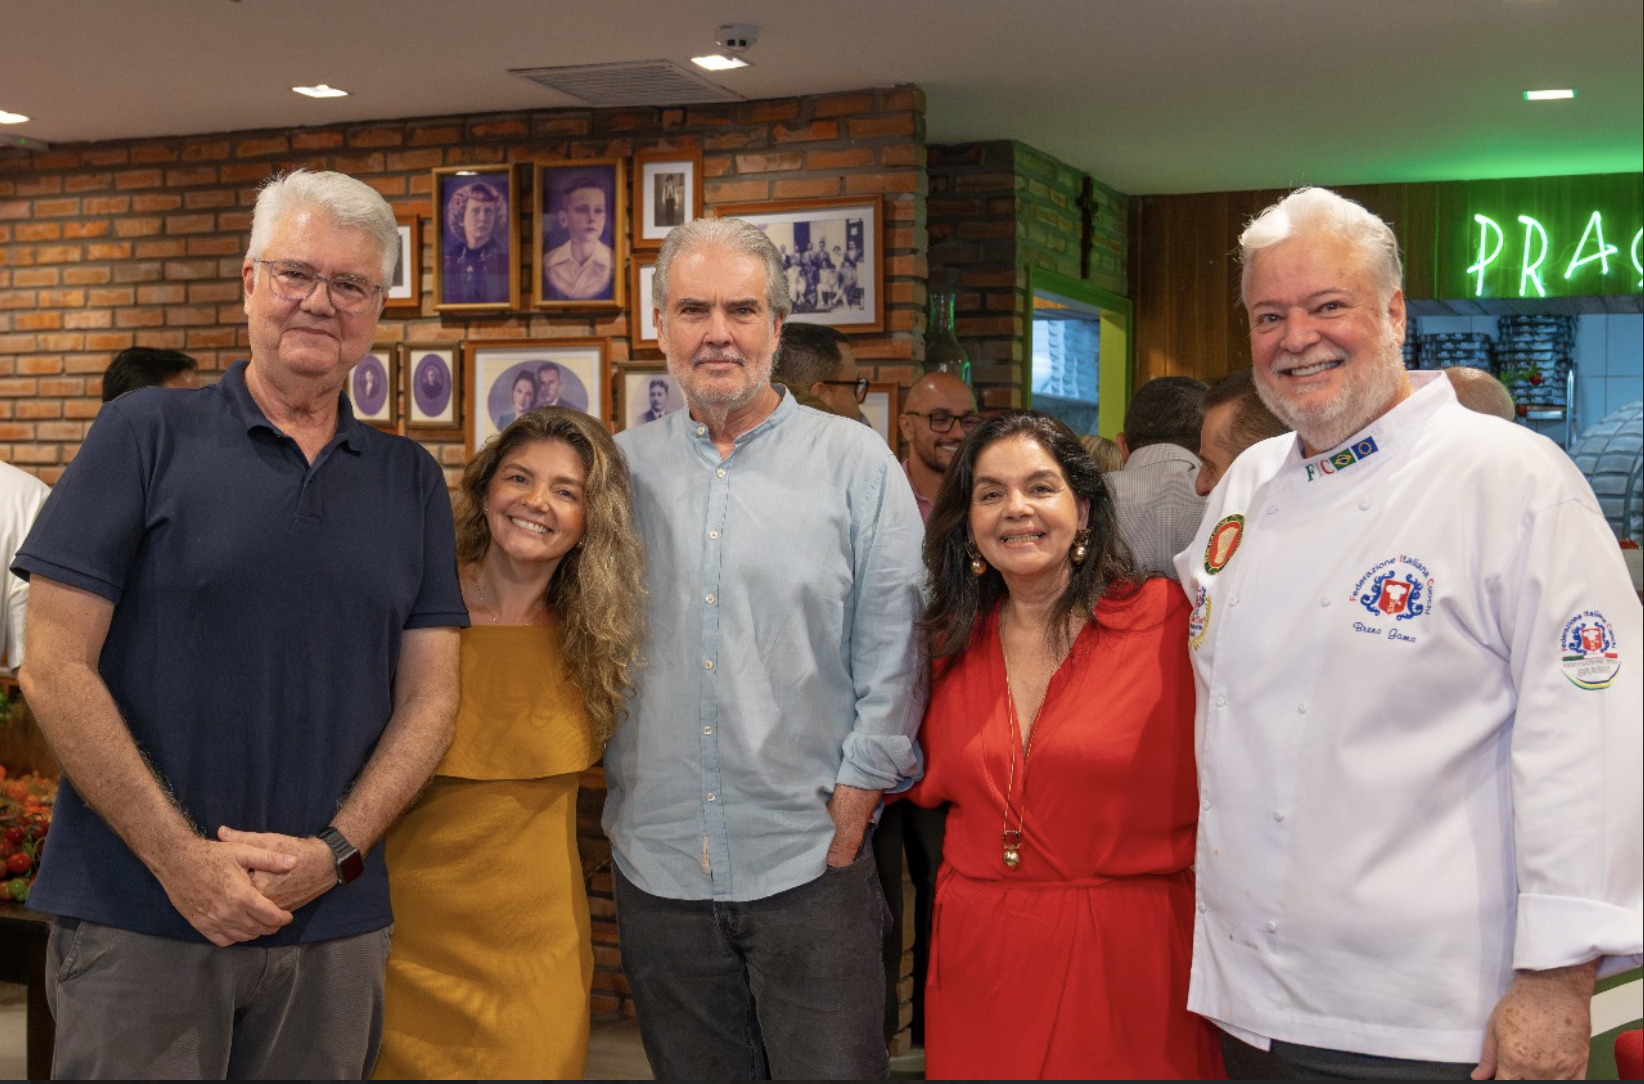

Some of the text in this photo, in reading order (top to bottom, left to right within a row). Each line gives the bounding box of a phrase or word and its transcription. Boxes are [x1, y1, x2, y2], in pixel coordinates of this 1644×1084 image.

[1305, 459, 1335, 482] FIC
[1349, 557, 1396, 602] Federazione
[1399, 554, 1430, 578] Italiana
[1353, 621, 1382, 635] Breno
